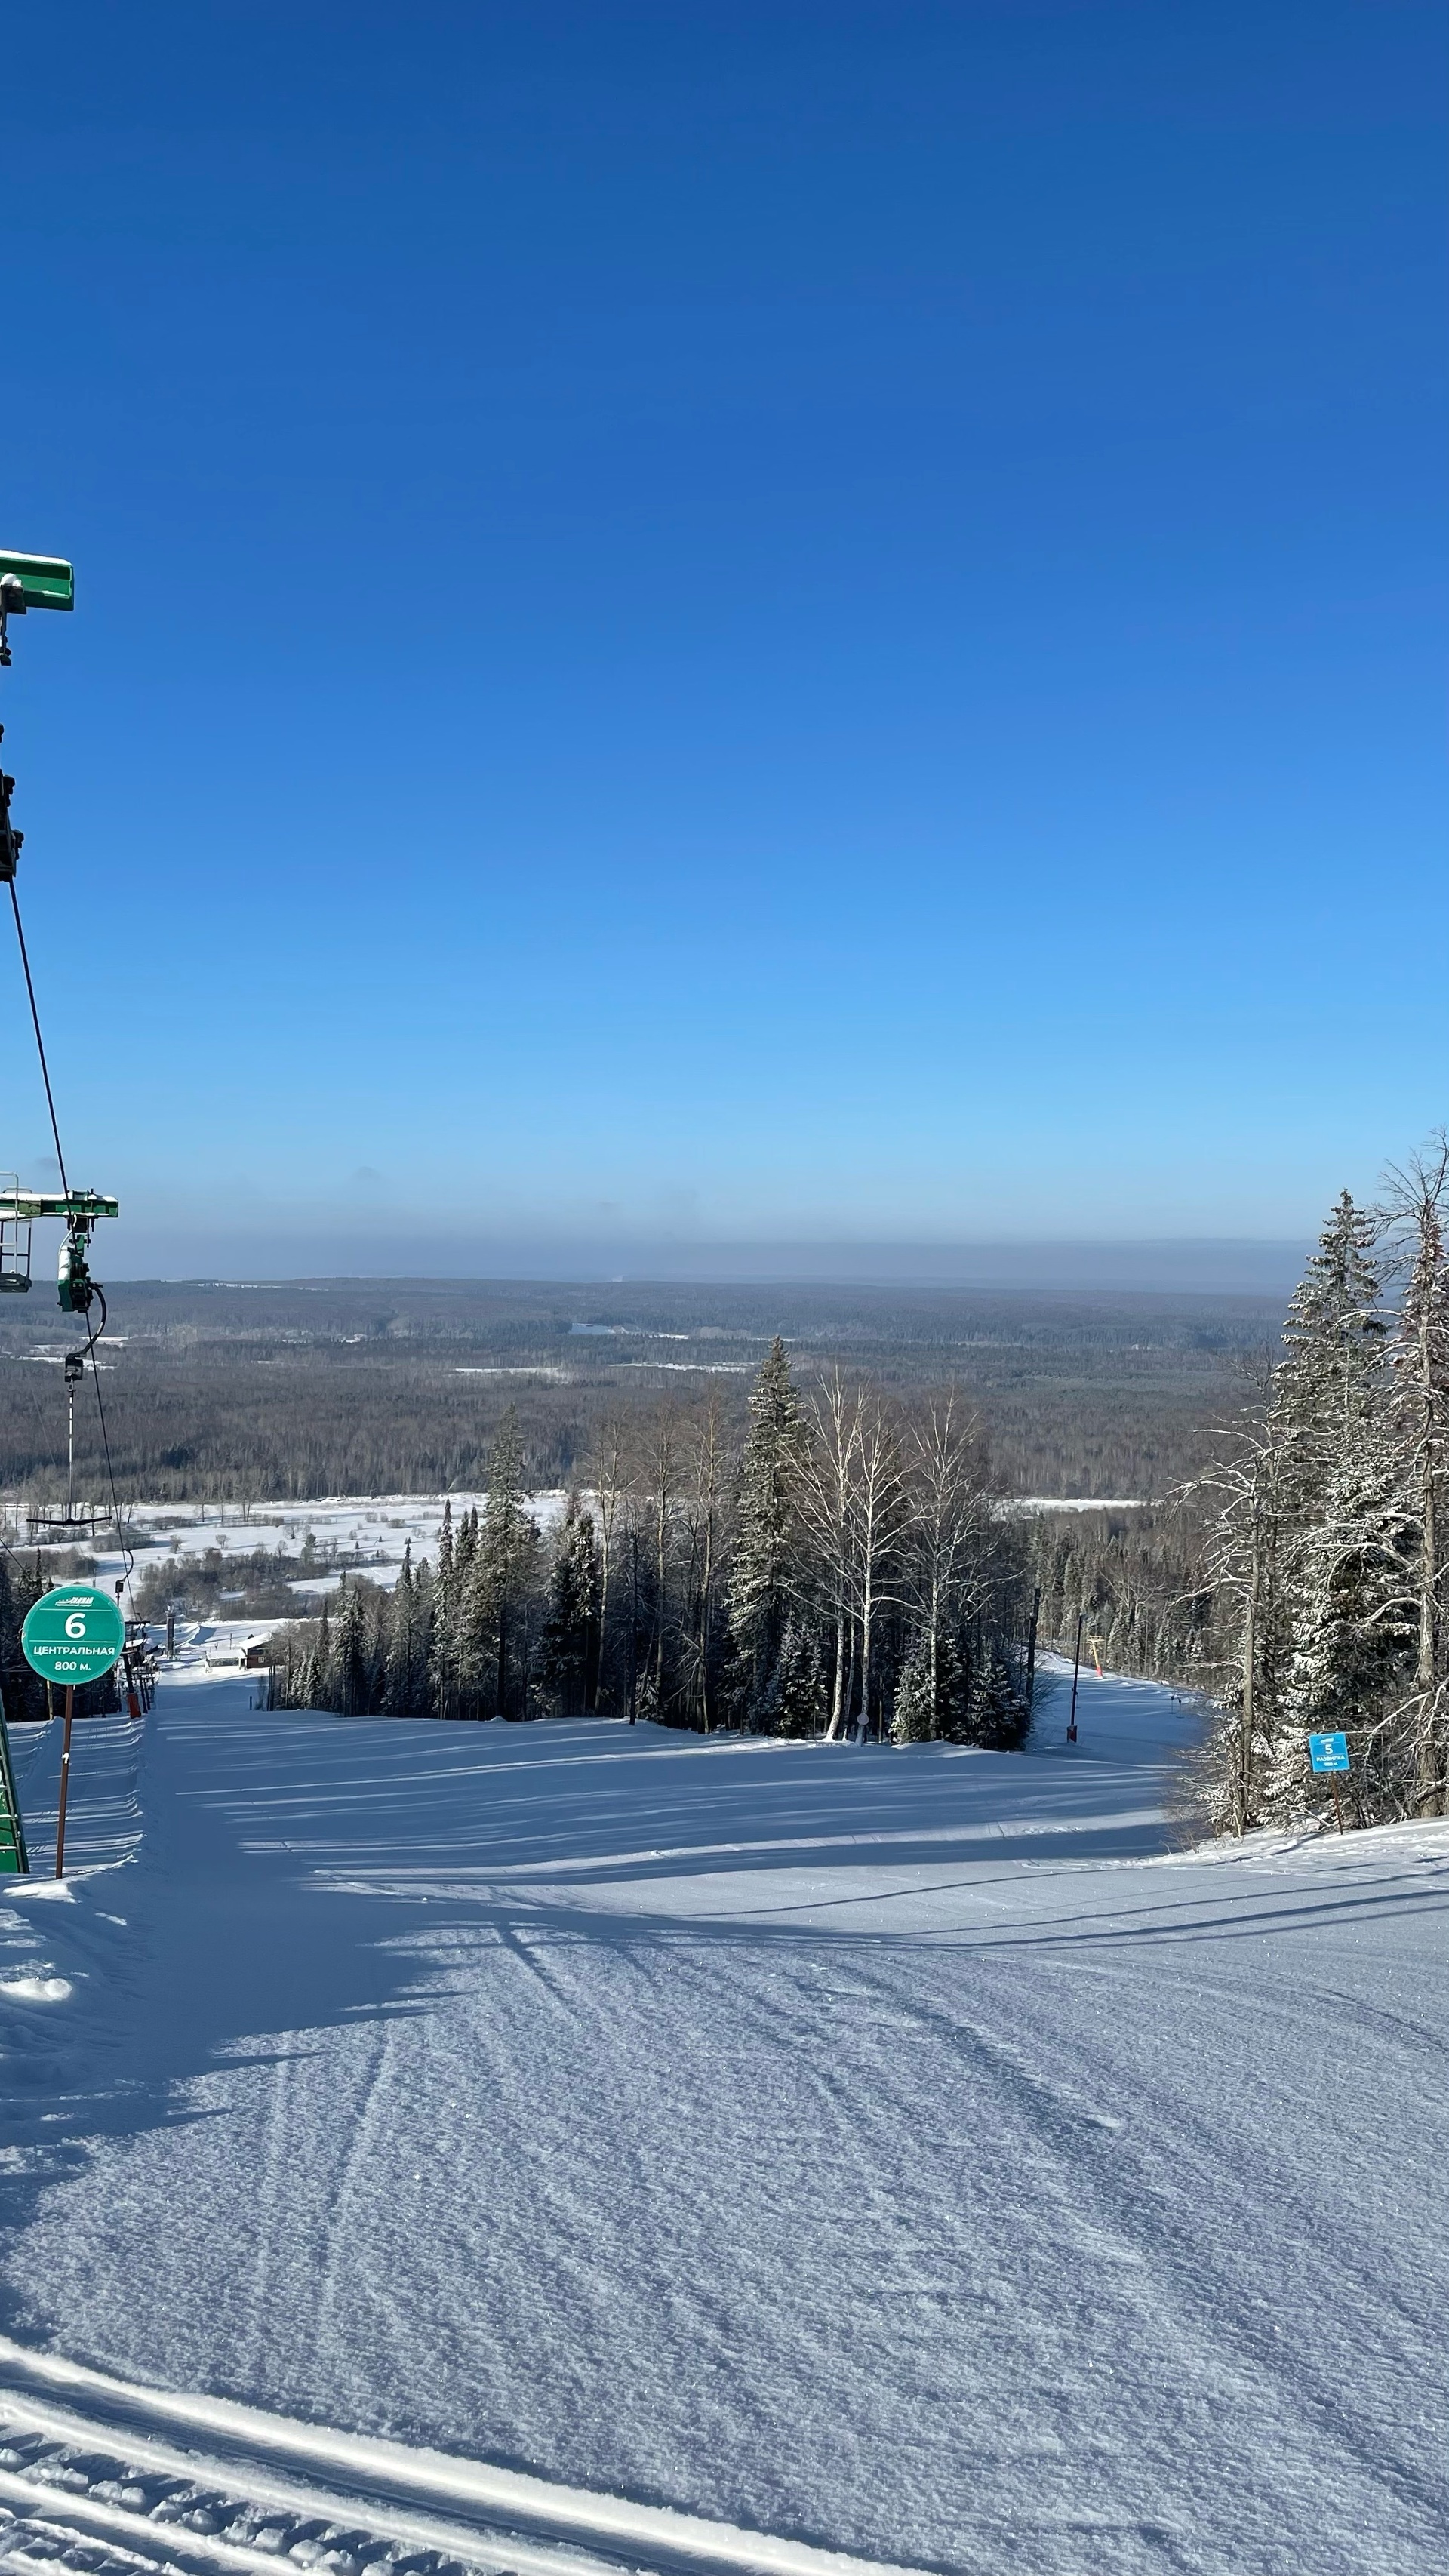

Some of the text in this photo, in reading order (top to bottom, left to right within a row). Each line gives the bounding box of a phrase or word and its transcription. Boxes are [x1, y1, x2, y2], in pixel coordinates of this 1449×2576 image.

[65, 1612, 86, 1639] 6
[33, 1646, 115, 1655] ЦЕНТРАЛЬНАЯ
[54, 1661, 77, 1670] 800
[1324, 1743, 1334, 1754] 5
